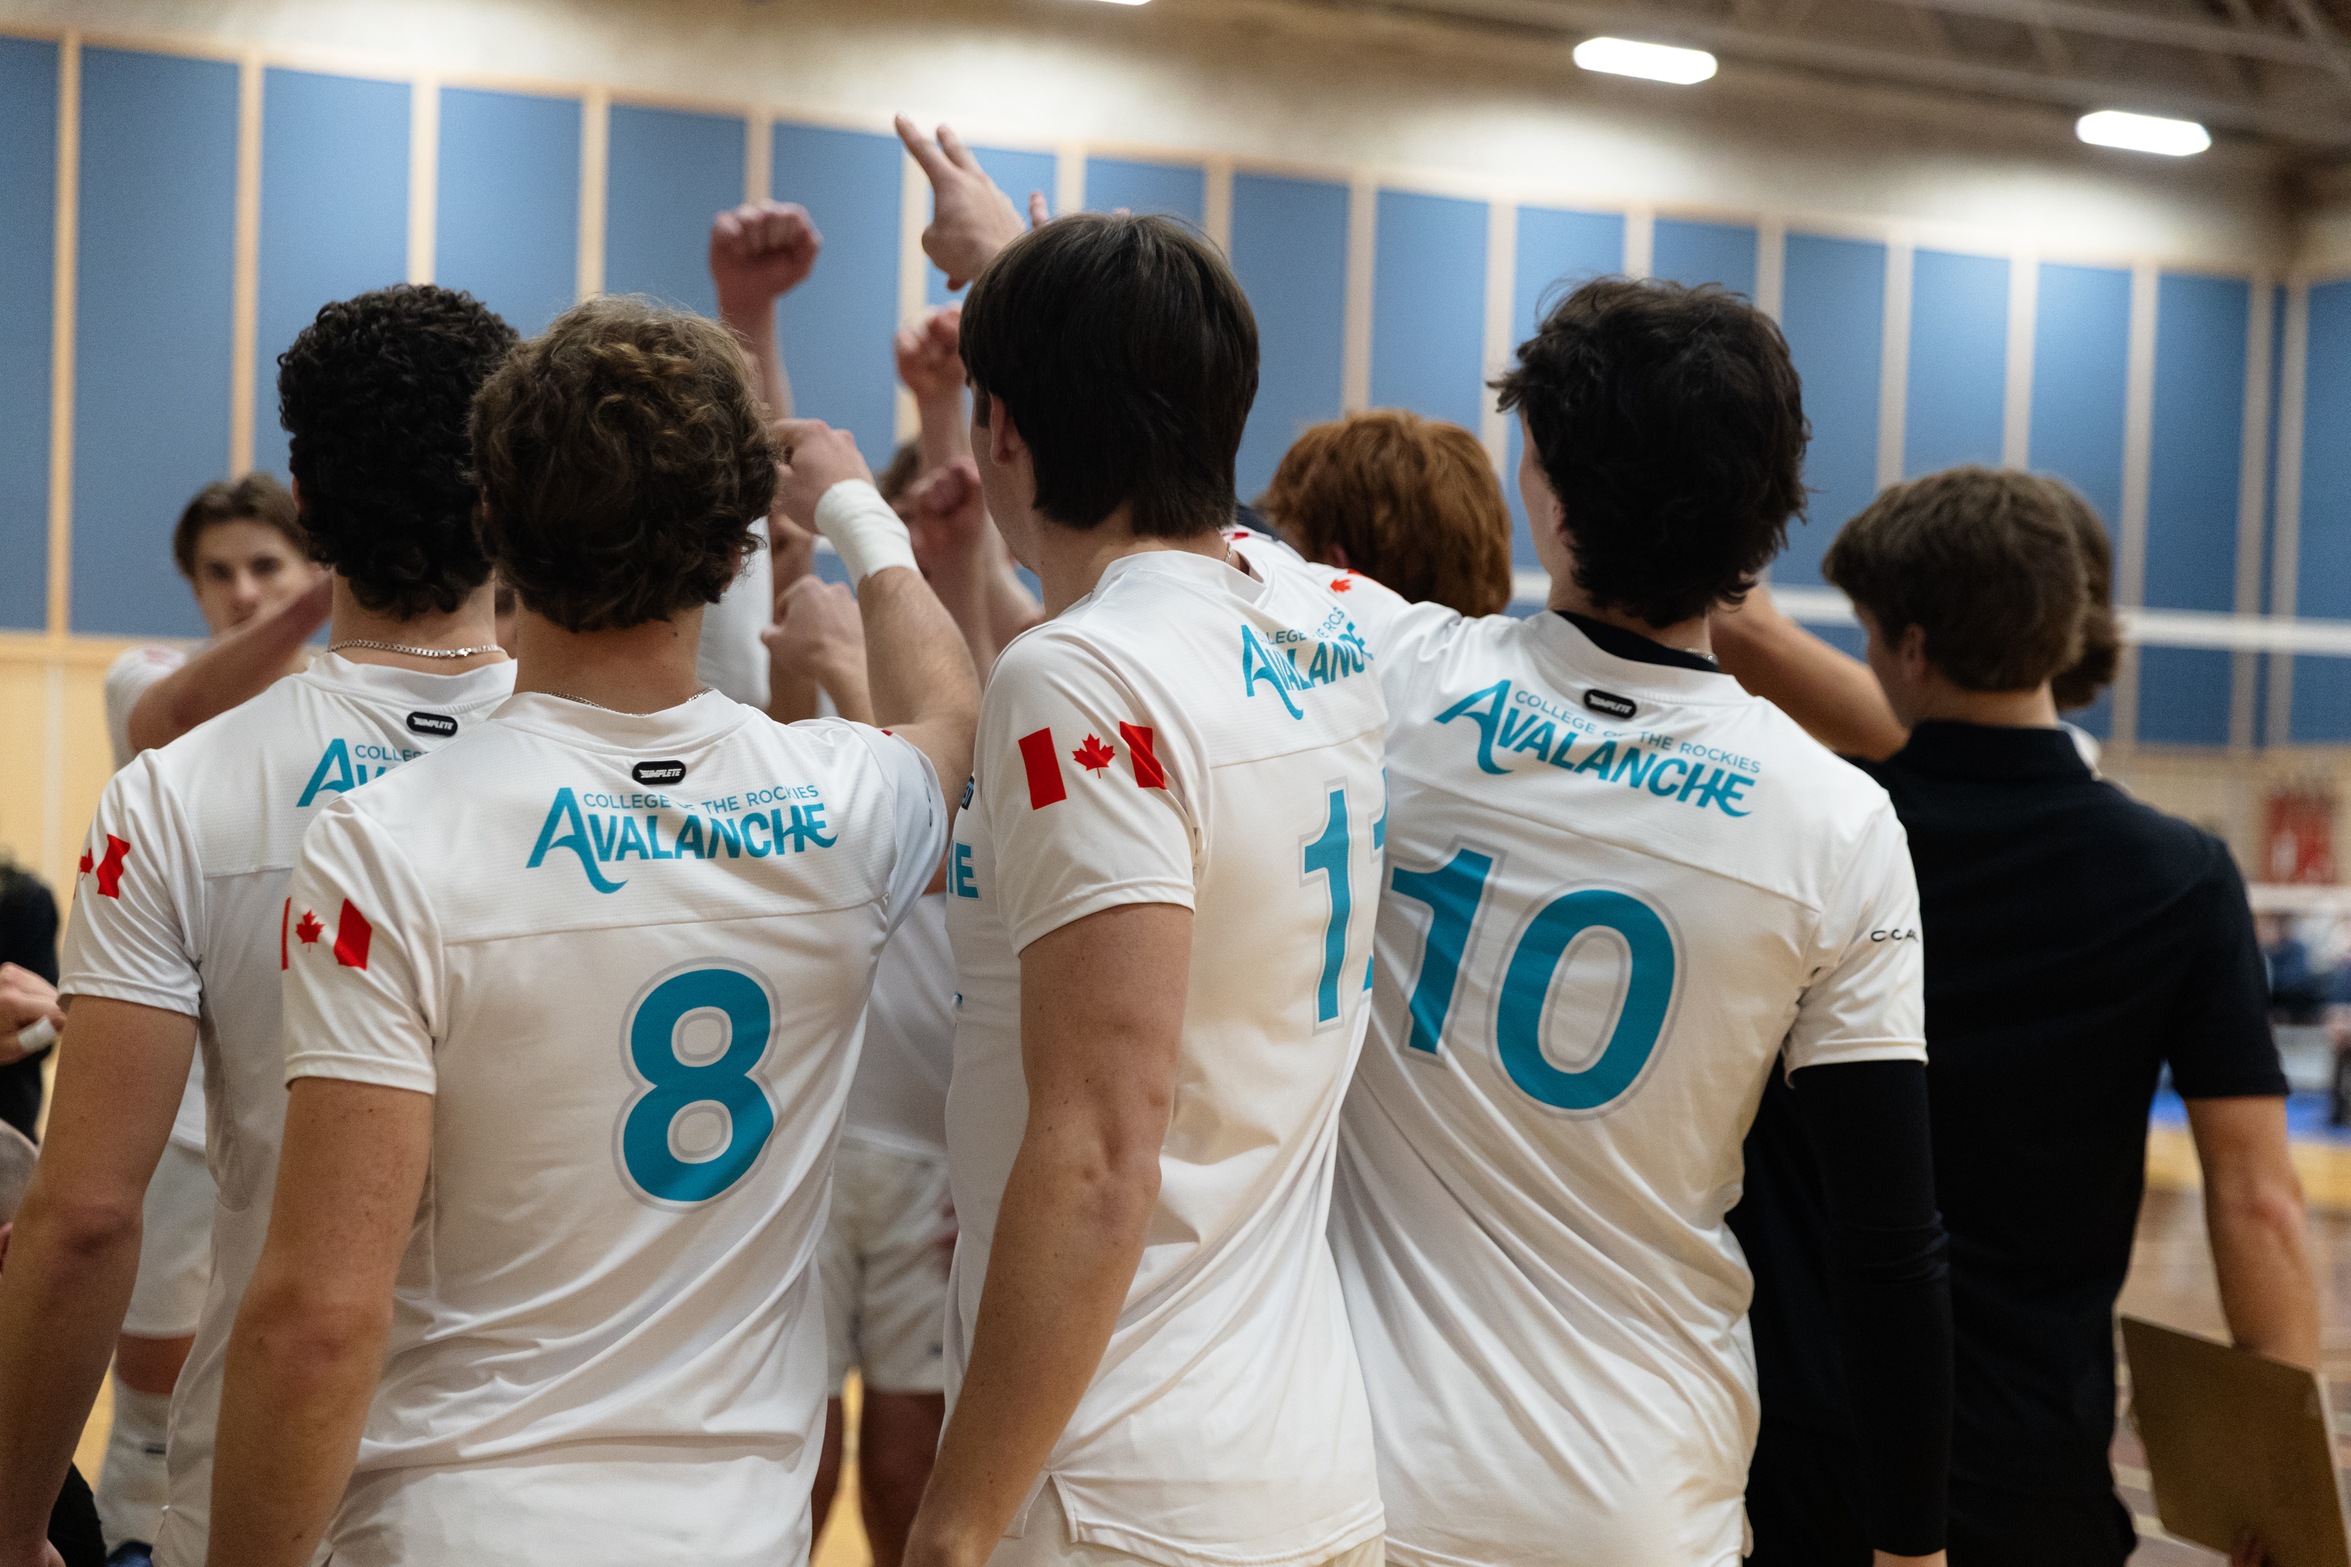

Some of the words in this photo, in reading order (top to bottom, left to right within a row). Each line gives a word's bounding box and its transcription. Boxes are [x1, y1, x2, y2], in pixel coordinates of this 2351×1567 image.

[1241, 622, 1374, 721] AVALANC
[1433, 679, 1756, 818] AVALANCHE
[1514, 690, 1597, 736] COLLEGE
[1640, 731, 1674, 751] THE
[1679, 742, 1761, 774] ROCKIES
[525, 787, 838, 894] AVALANCHE
[583, 793, 672, 810] COLLEGE
[701, 795, 740, 814] THE
[746, 785, 819, 807] ROCKIES
[1391, 848, 1676, 1111] 10
[623, 969, 774, 1202] 8
